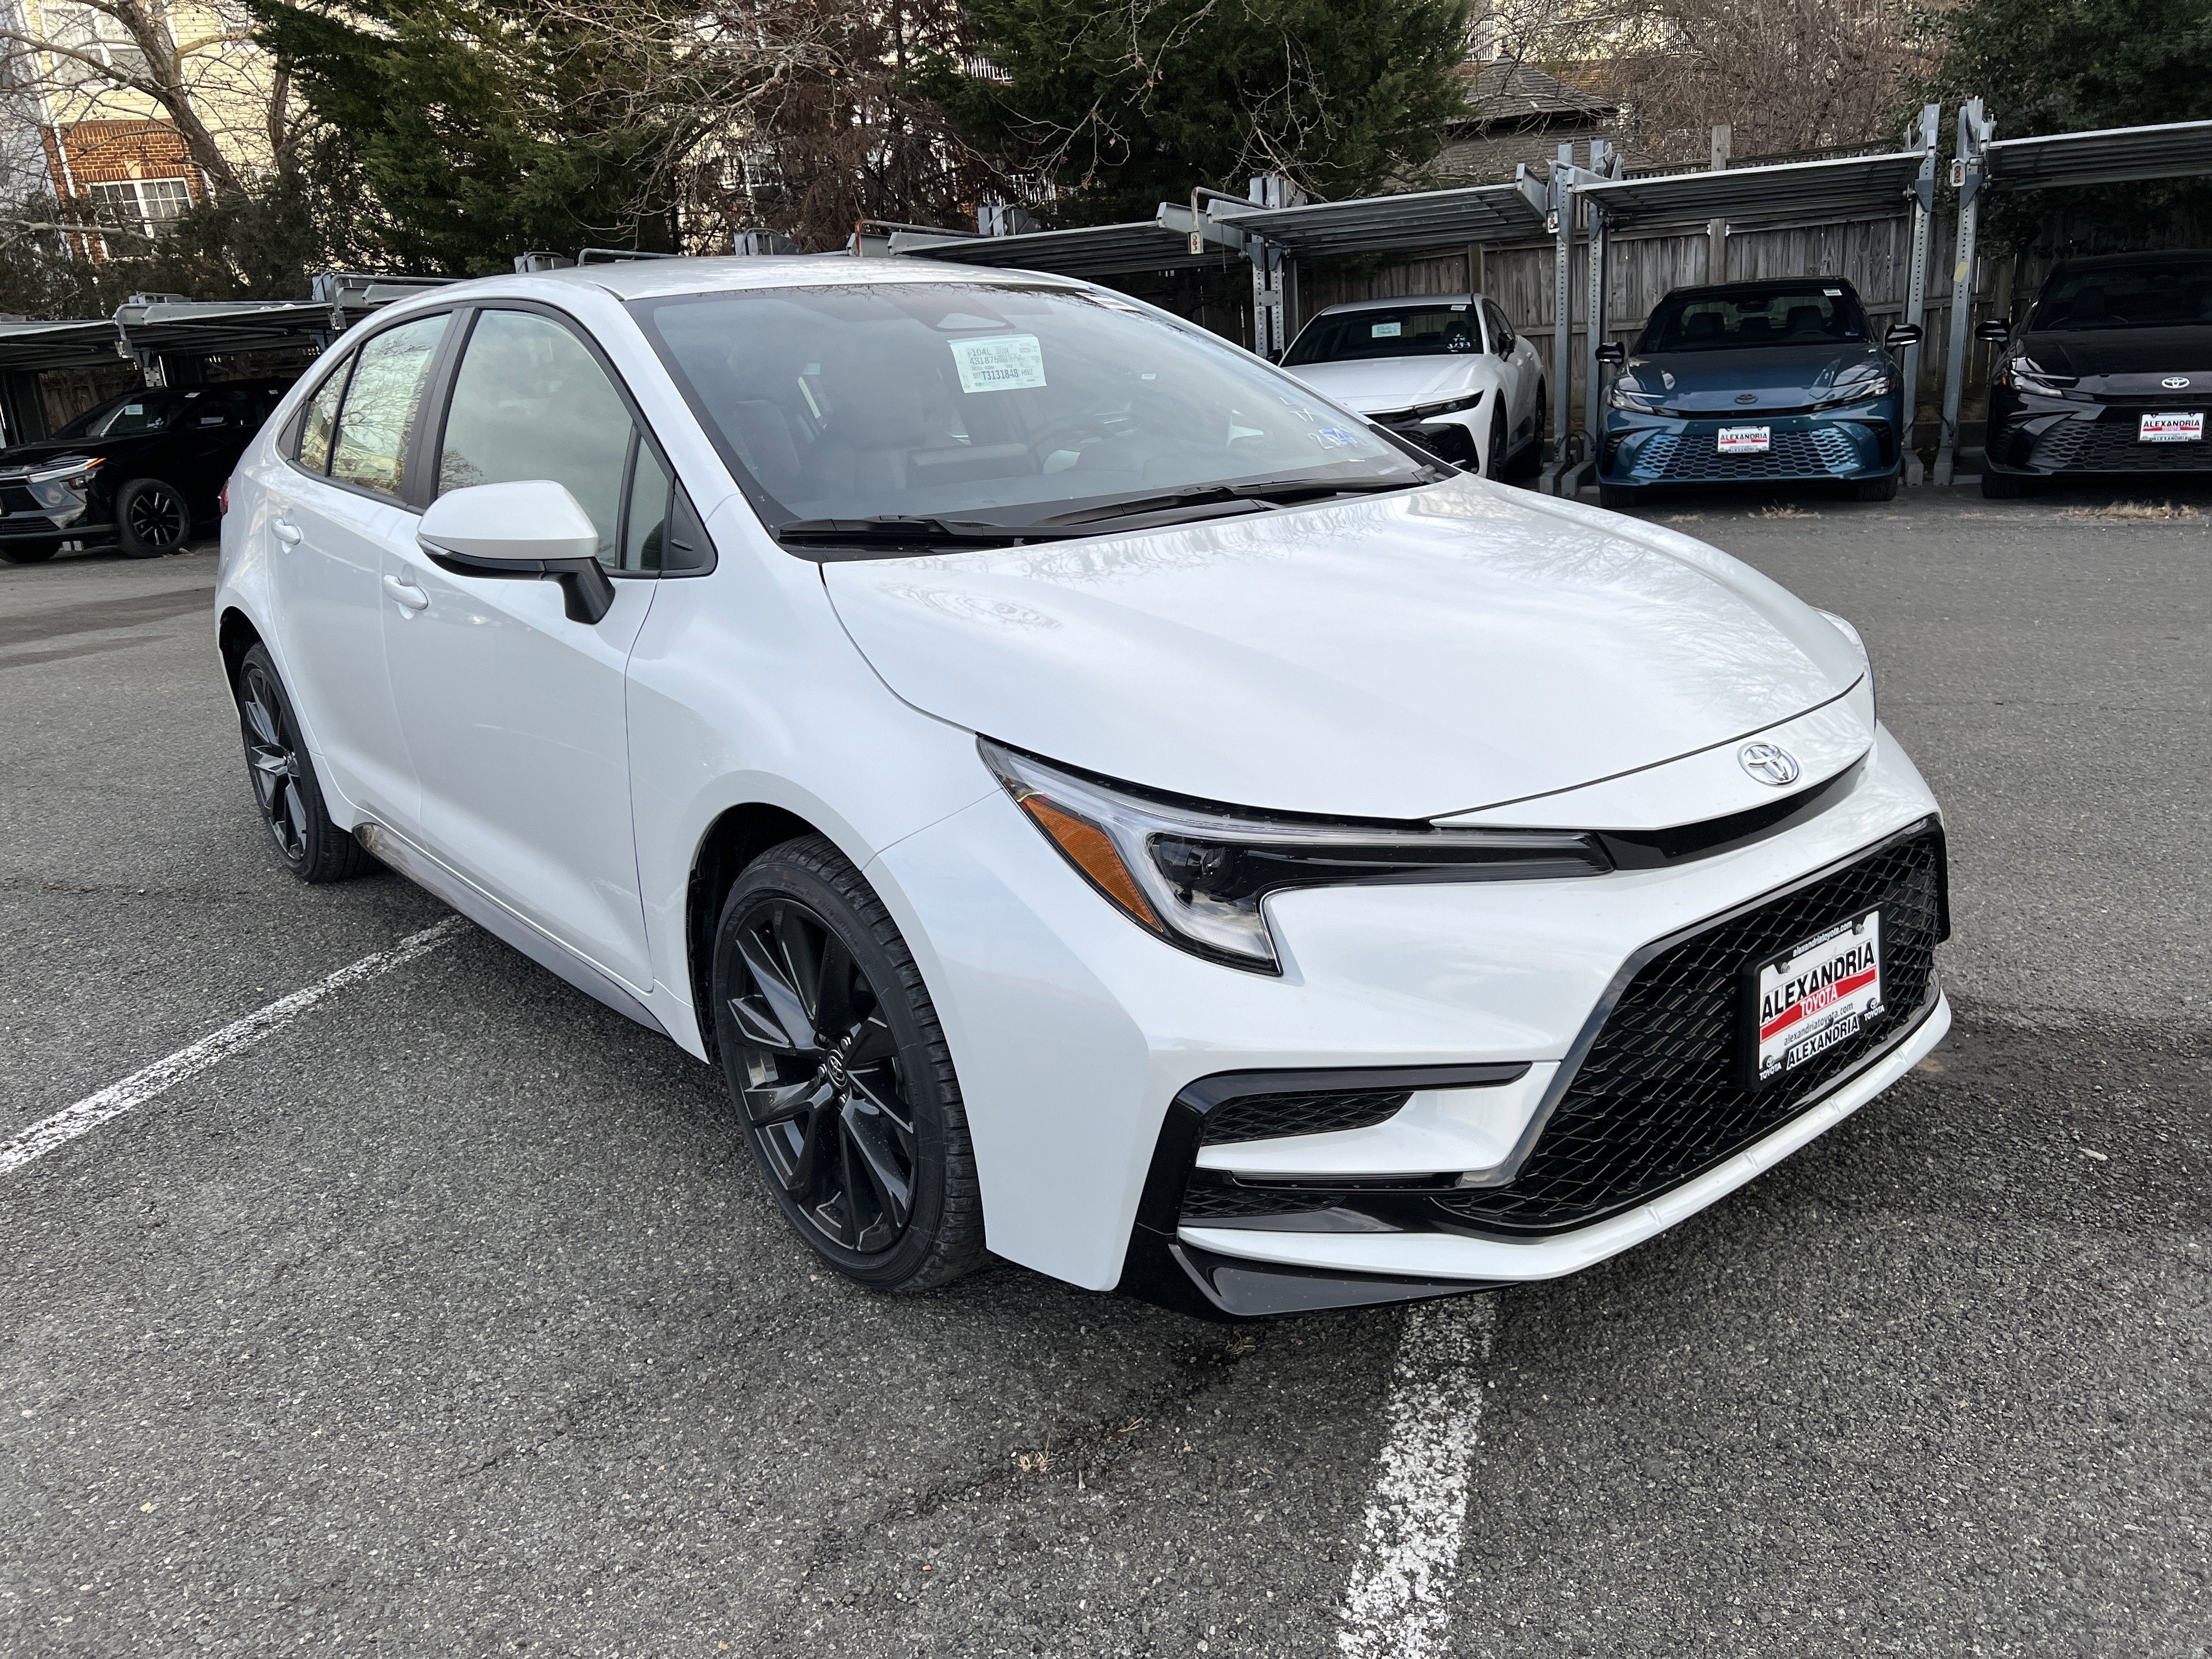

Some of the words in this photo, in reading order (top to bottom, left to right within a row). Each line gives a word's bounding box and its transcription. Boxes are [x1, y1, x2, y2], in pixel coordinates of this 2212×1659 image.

[981, 368, 1019, 381] T3131848
[1793, 921, 1853, 957] alexandriatoyota.com
[1761, 940, 1876, 1024] ALEXANDRIA
[1800, 986, 1838, 1016] TOYOTA
[1864, 1004, 1885, 1022] TOYOTA
[1784, 1002, 1853, 1046] alexandriatoyota.com
[1787, 1017, 1859, 1069] ALEXANDRIA
[1759, 1062, 1782, 1081] TOYOTA
